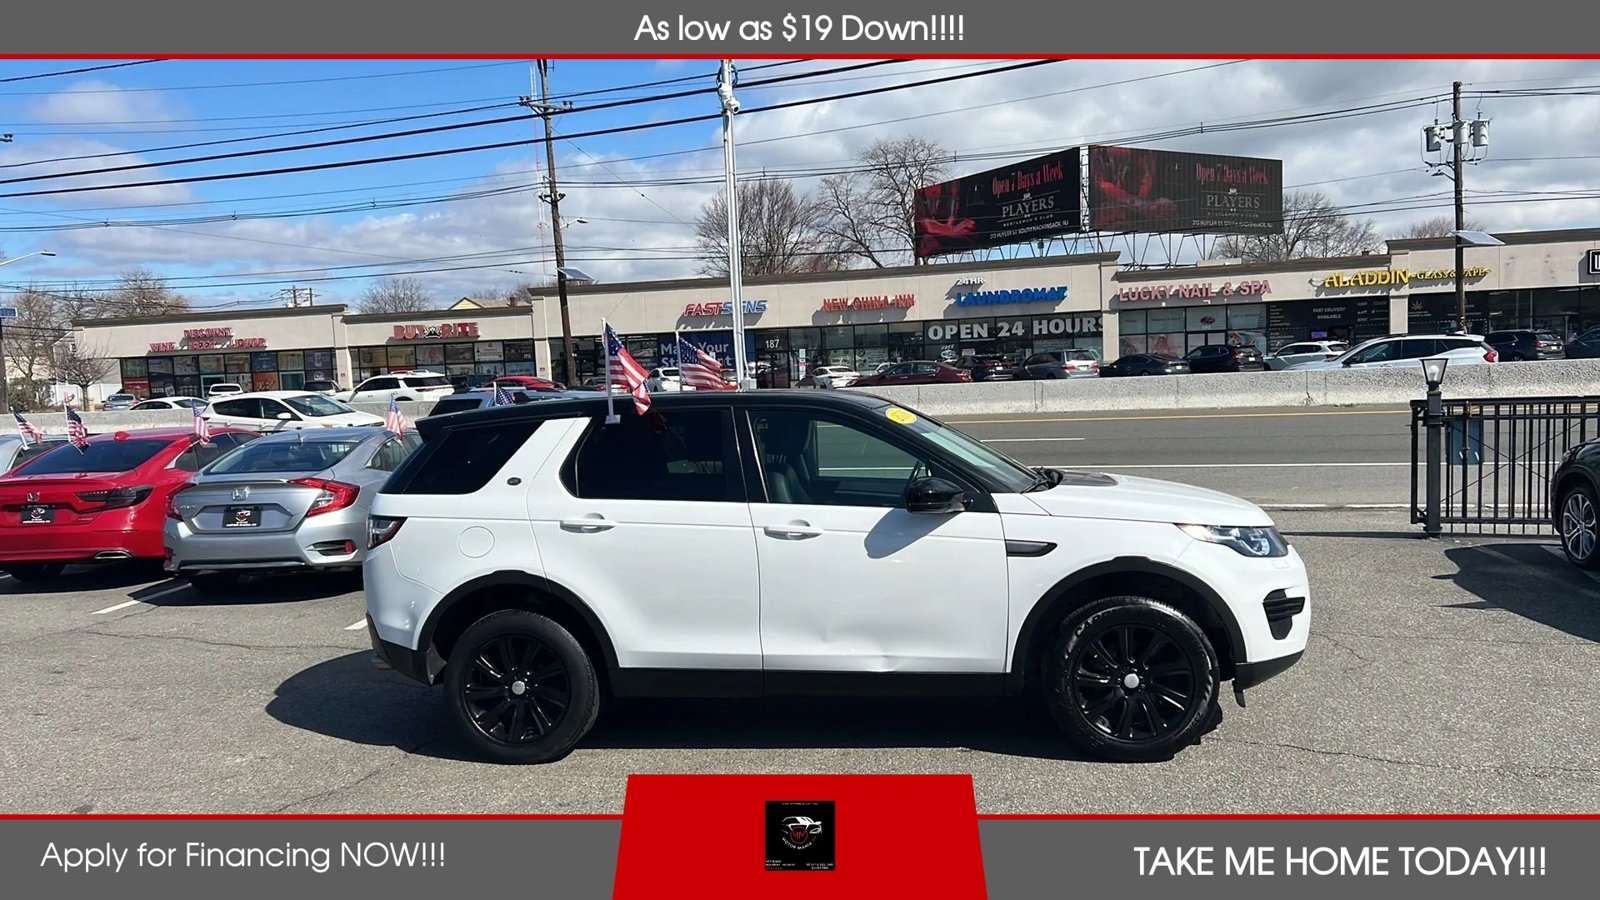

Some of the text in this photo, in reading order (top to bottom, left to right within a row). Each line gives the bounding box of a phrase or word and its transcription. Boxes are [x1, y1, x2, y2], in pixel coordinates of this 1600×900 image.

[992, 177, 1010, 198] Open
[1011, 172, 1016, 191] 7
[1017, 171, 1035, 190] Days
[1043, 161, 1064, 183] Week
[1196, 163, 1215, 185] Open
[1217, 164, 1222, 182] 7
[1223, 164, 1240, 183] Days
[1249, 165, 1269, 185] Week
[1002, 196, 1055, 217] PLAYERS
[1206, 195, 1260, 208] PLAYERS
[957, 278, 969, 286] 24
[1324, 268, 1409, 289] ALADDIN
[957, 286, 1068, 306] LAUNDROMAT
[1119, 279, 1272, 302] LUCKY NAIL & SPA
[823, 293, 915, 312] NEW CHINA INN
[183, 327, 232, 339] DISCOUNT
[393, 322, 479, 339] BUY RITE
[928, 322, 989, 341] OPEN
[997, 320, 1025, 337] 24
[150, 342, 175, 352] WINE
[230, 338, 267, 348] LIQUOR
[698, 342, 729, 353] Your
[765, 339, 779, 348] 187
